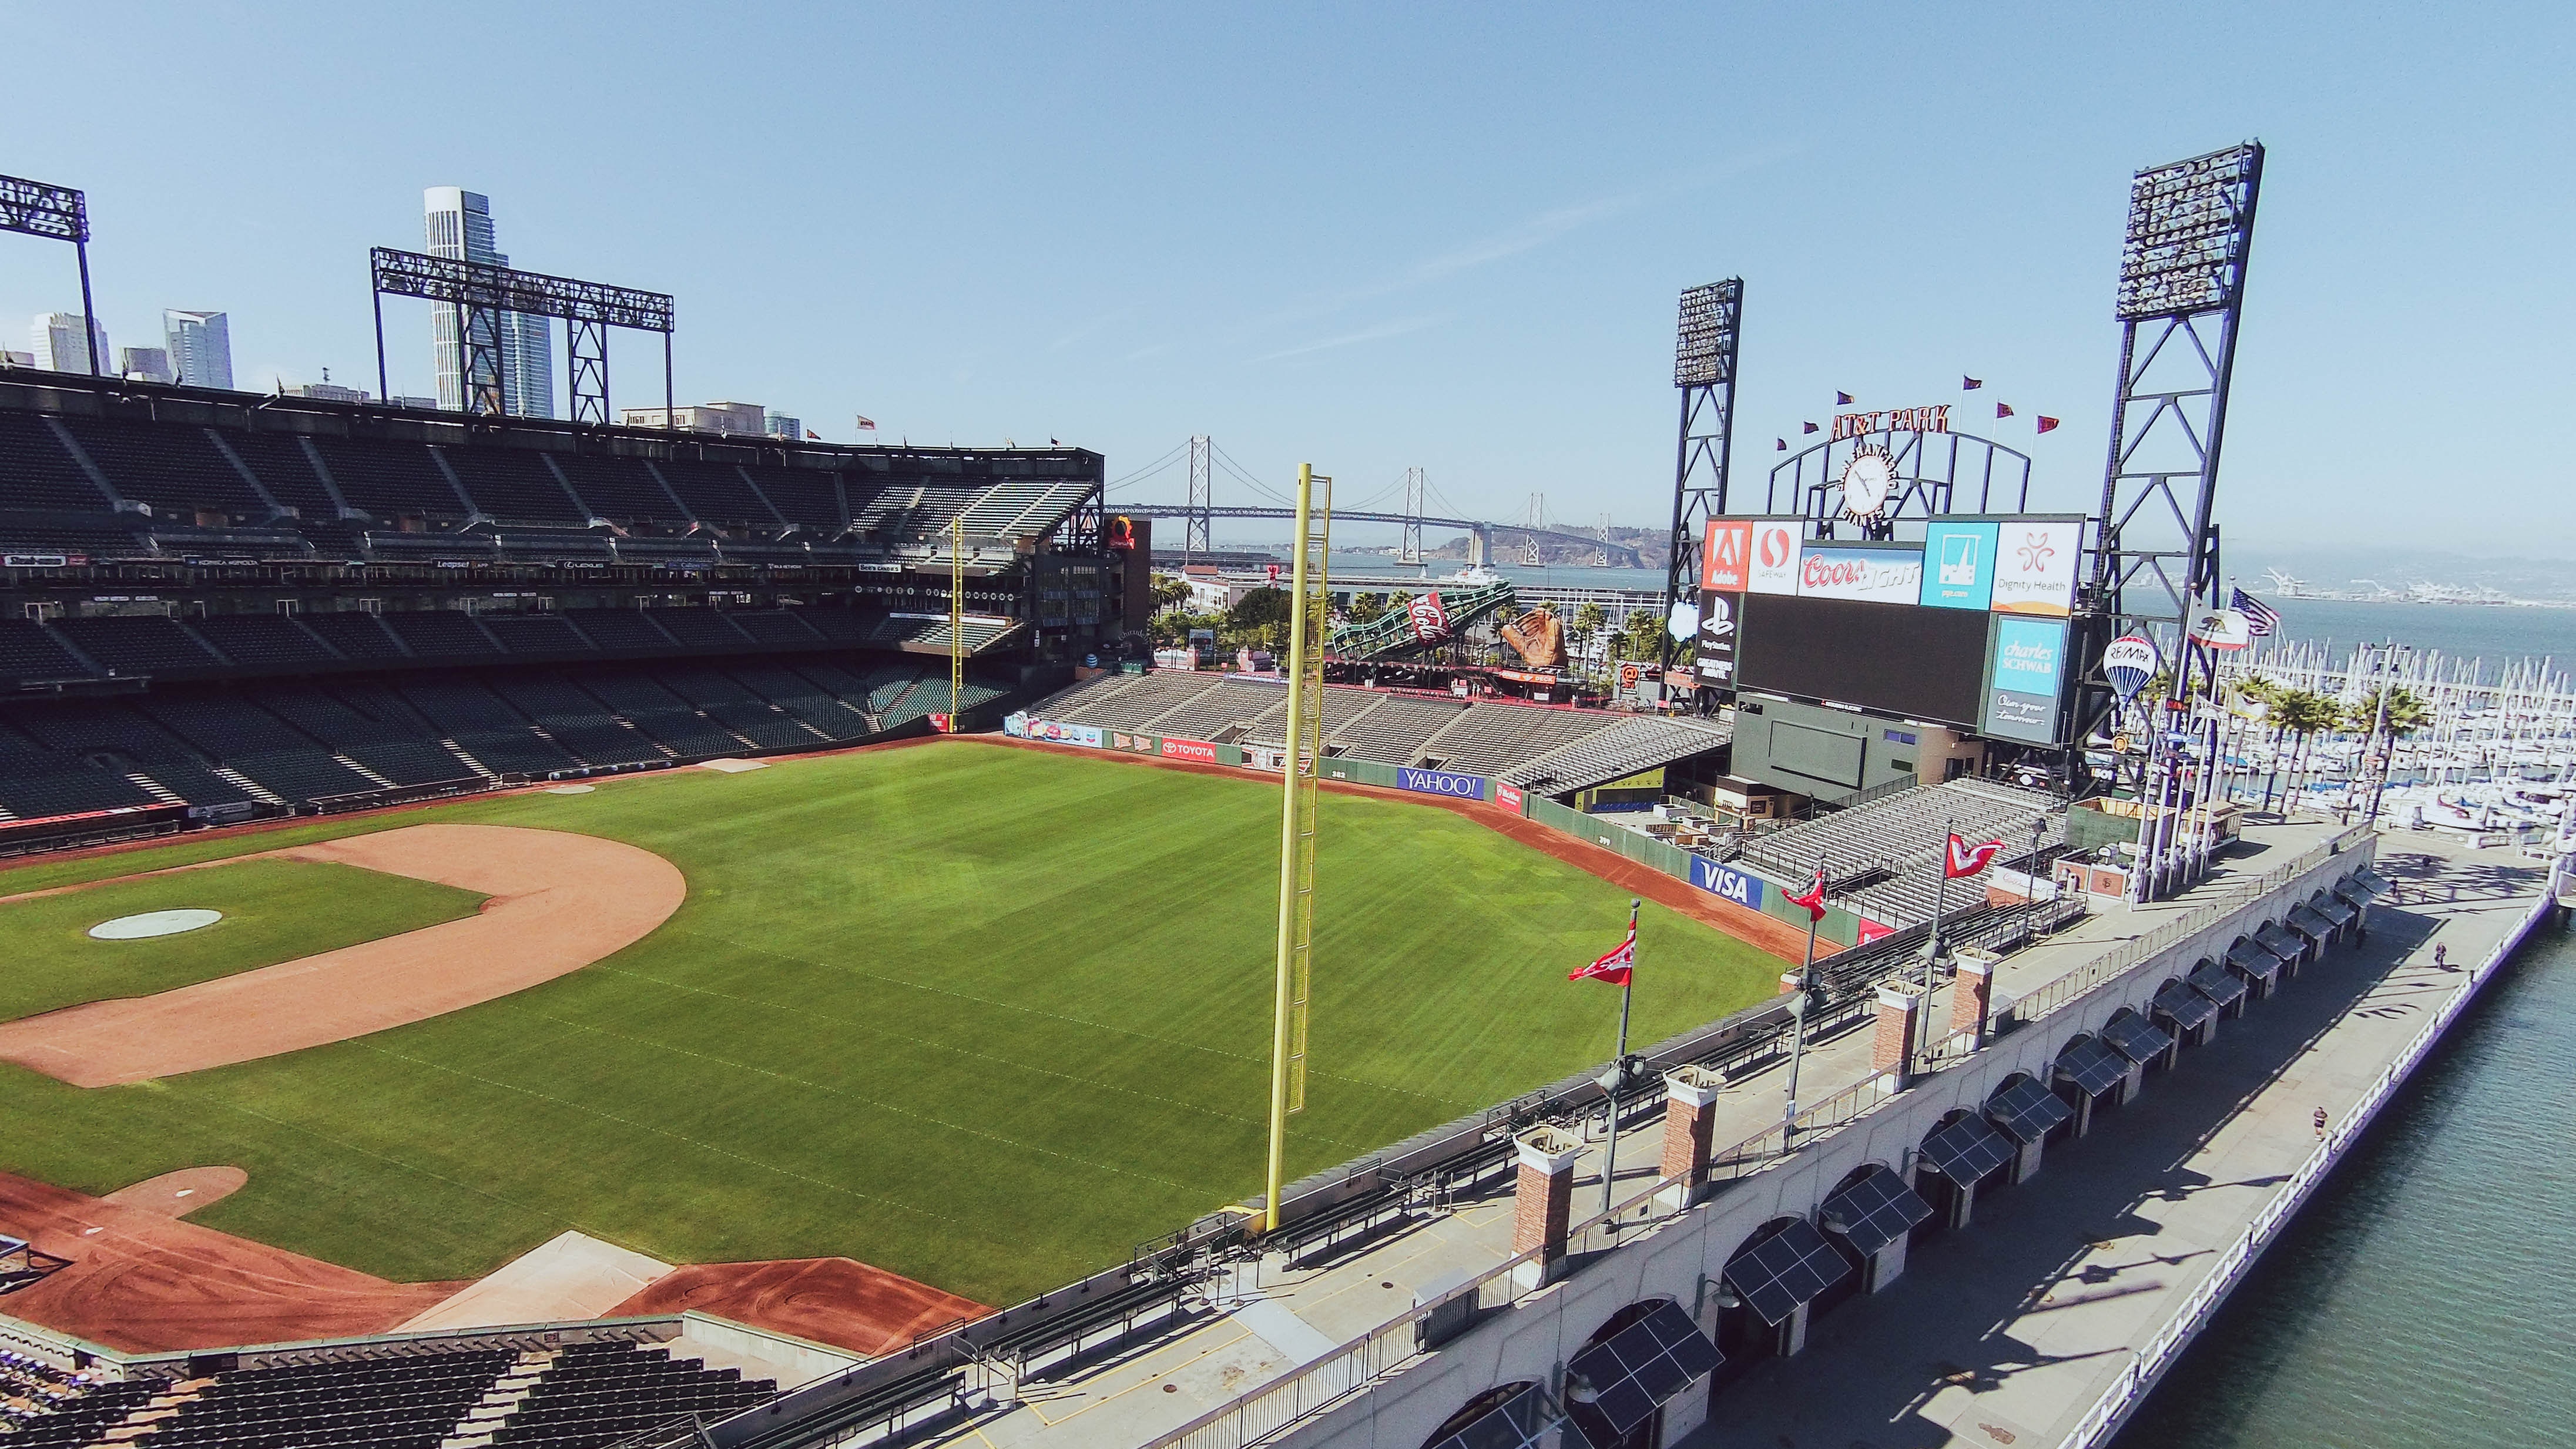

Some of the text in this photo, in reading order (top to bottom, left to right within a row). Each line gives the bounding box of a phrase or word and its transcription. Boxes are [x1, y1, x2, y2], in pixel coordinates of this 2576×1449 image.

[1829, 405, 1953, 442] AT&T PARK
[1834, 443, 1899, 492] SAN FRANCISCO
[1842, 507, 1886, 527] GIANTS
[1711, 570, 1738, 586] Adobe
[1757, 569, 1786, 579] SAFEWAY
[1803, 553, 1865, 588] Coors
[1998, 578, 2066, 592] Dignity Health
[2004, 640, 2053, 660] charles
[2111, 647, 2149, 662] RE/MAX
[1696, 657, 1733, 672] GREATNESS
[2002, 658, 2052, 674] SCHWAB
[1997, 694, 2046, 715] Own your
[1178, 744, 1214, 758] TOYOTA
[1331, 770, 1346, 779] 382
[1405, 769, 1477, 797] YAHOO!
[1598, 836, 1611, 847] 399
[1700, 860, 1748, 904] VISA
